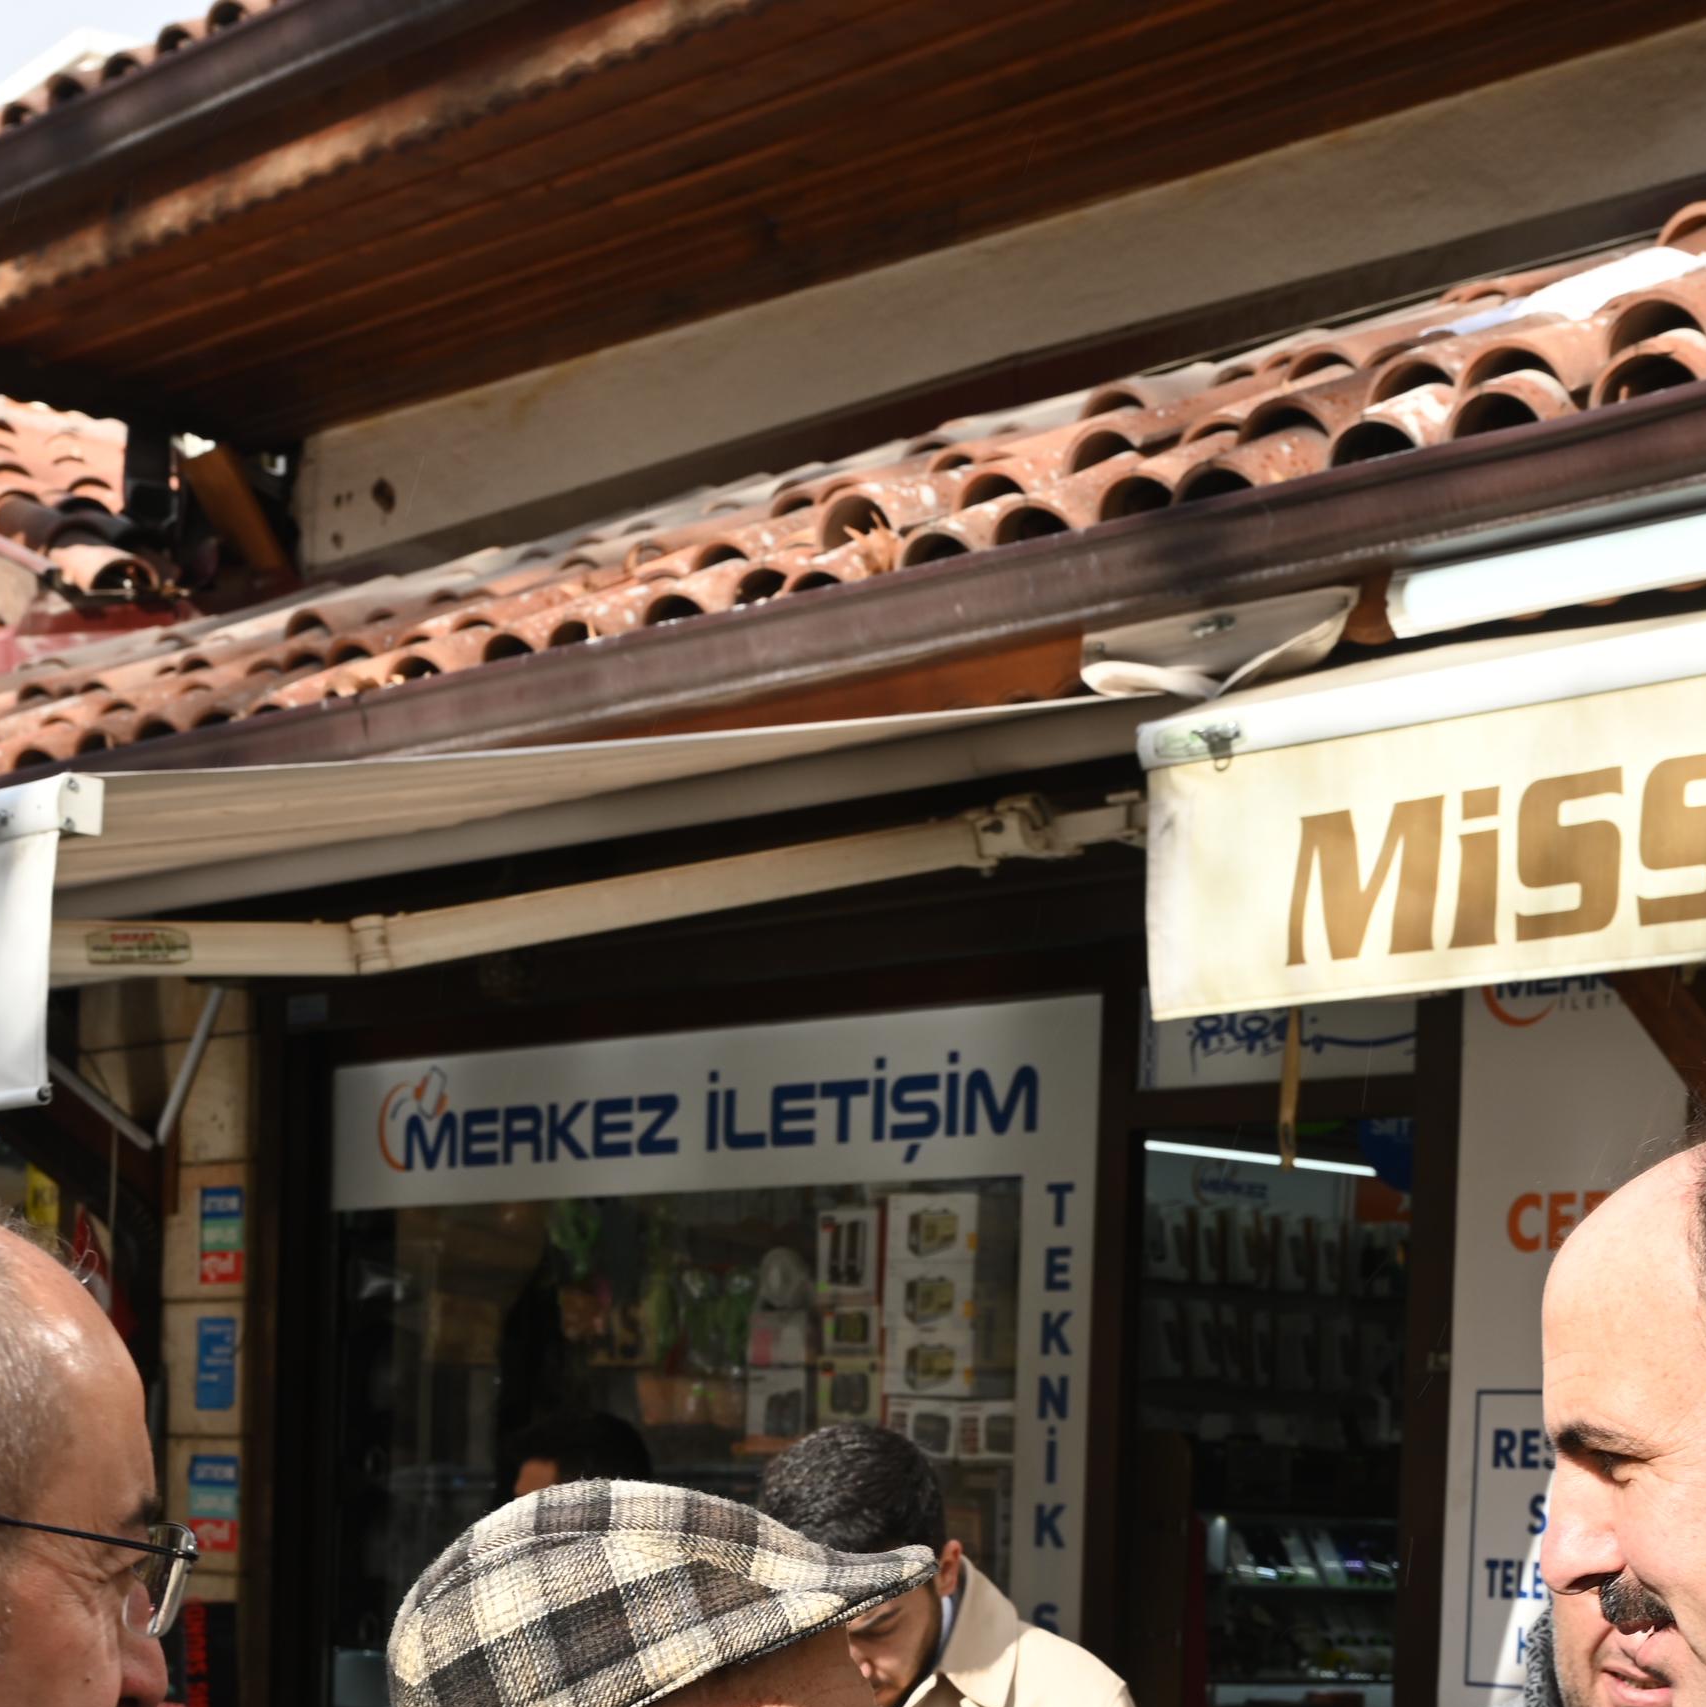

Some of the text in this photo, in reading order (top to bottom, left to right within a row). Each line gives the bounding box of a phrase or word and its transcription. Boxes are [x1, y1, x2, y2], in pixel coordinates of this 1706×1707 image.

[405, 1051, 1038, 1171] MERKEZ İLETİŞİM
[1486, 1558, 1551, 1600] TELE
